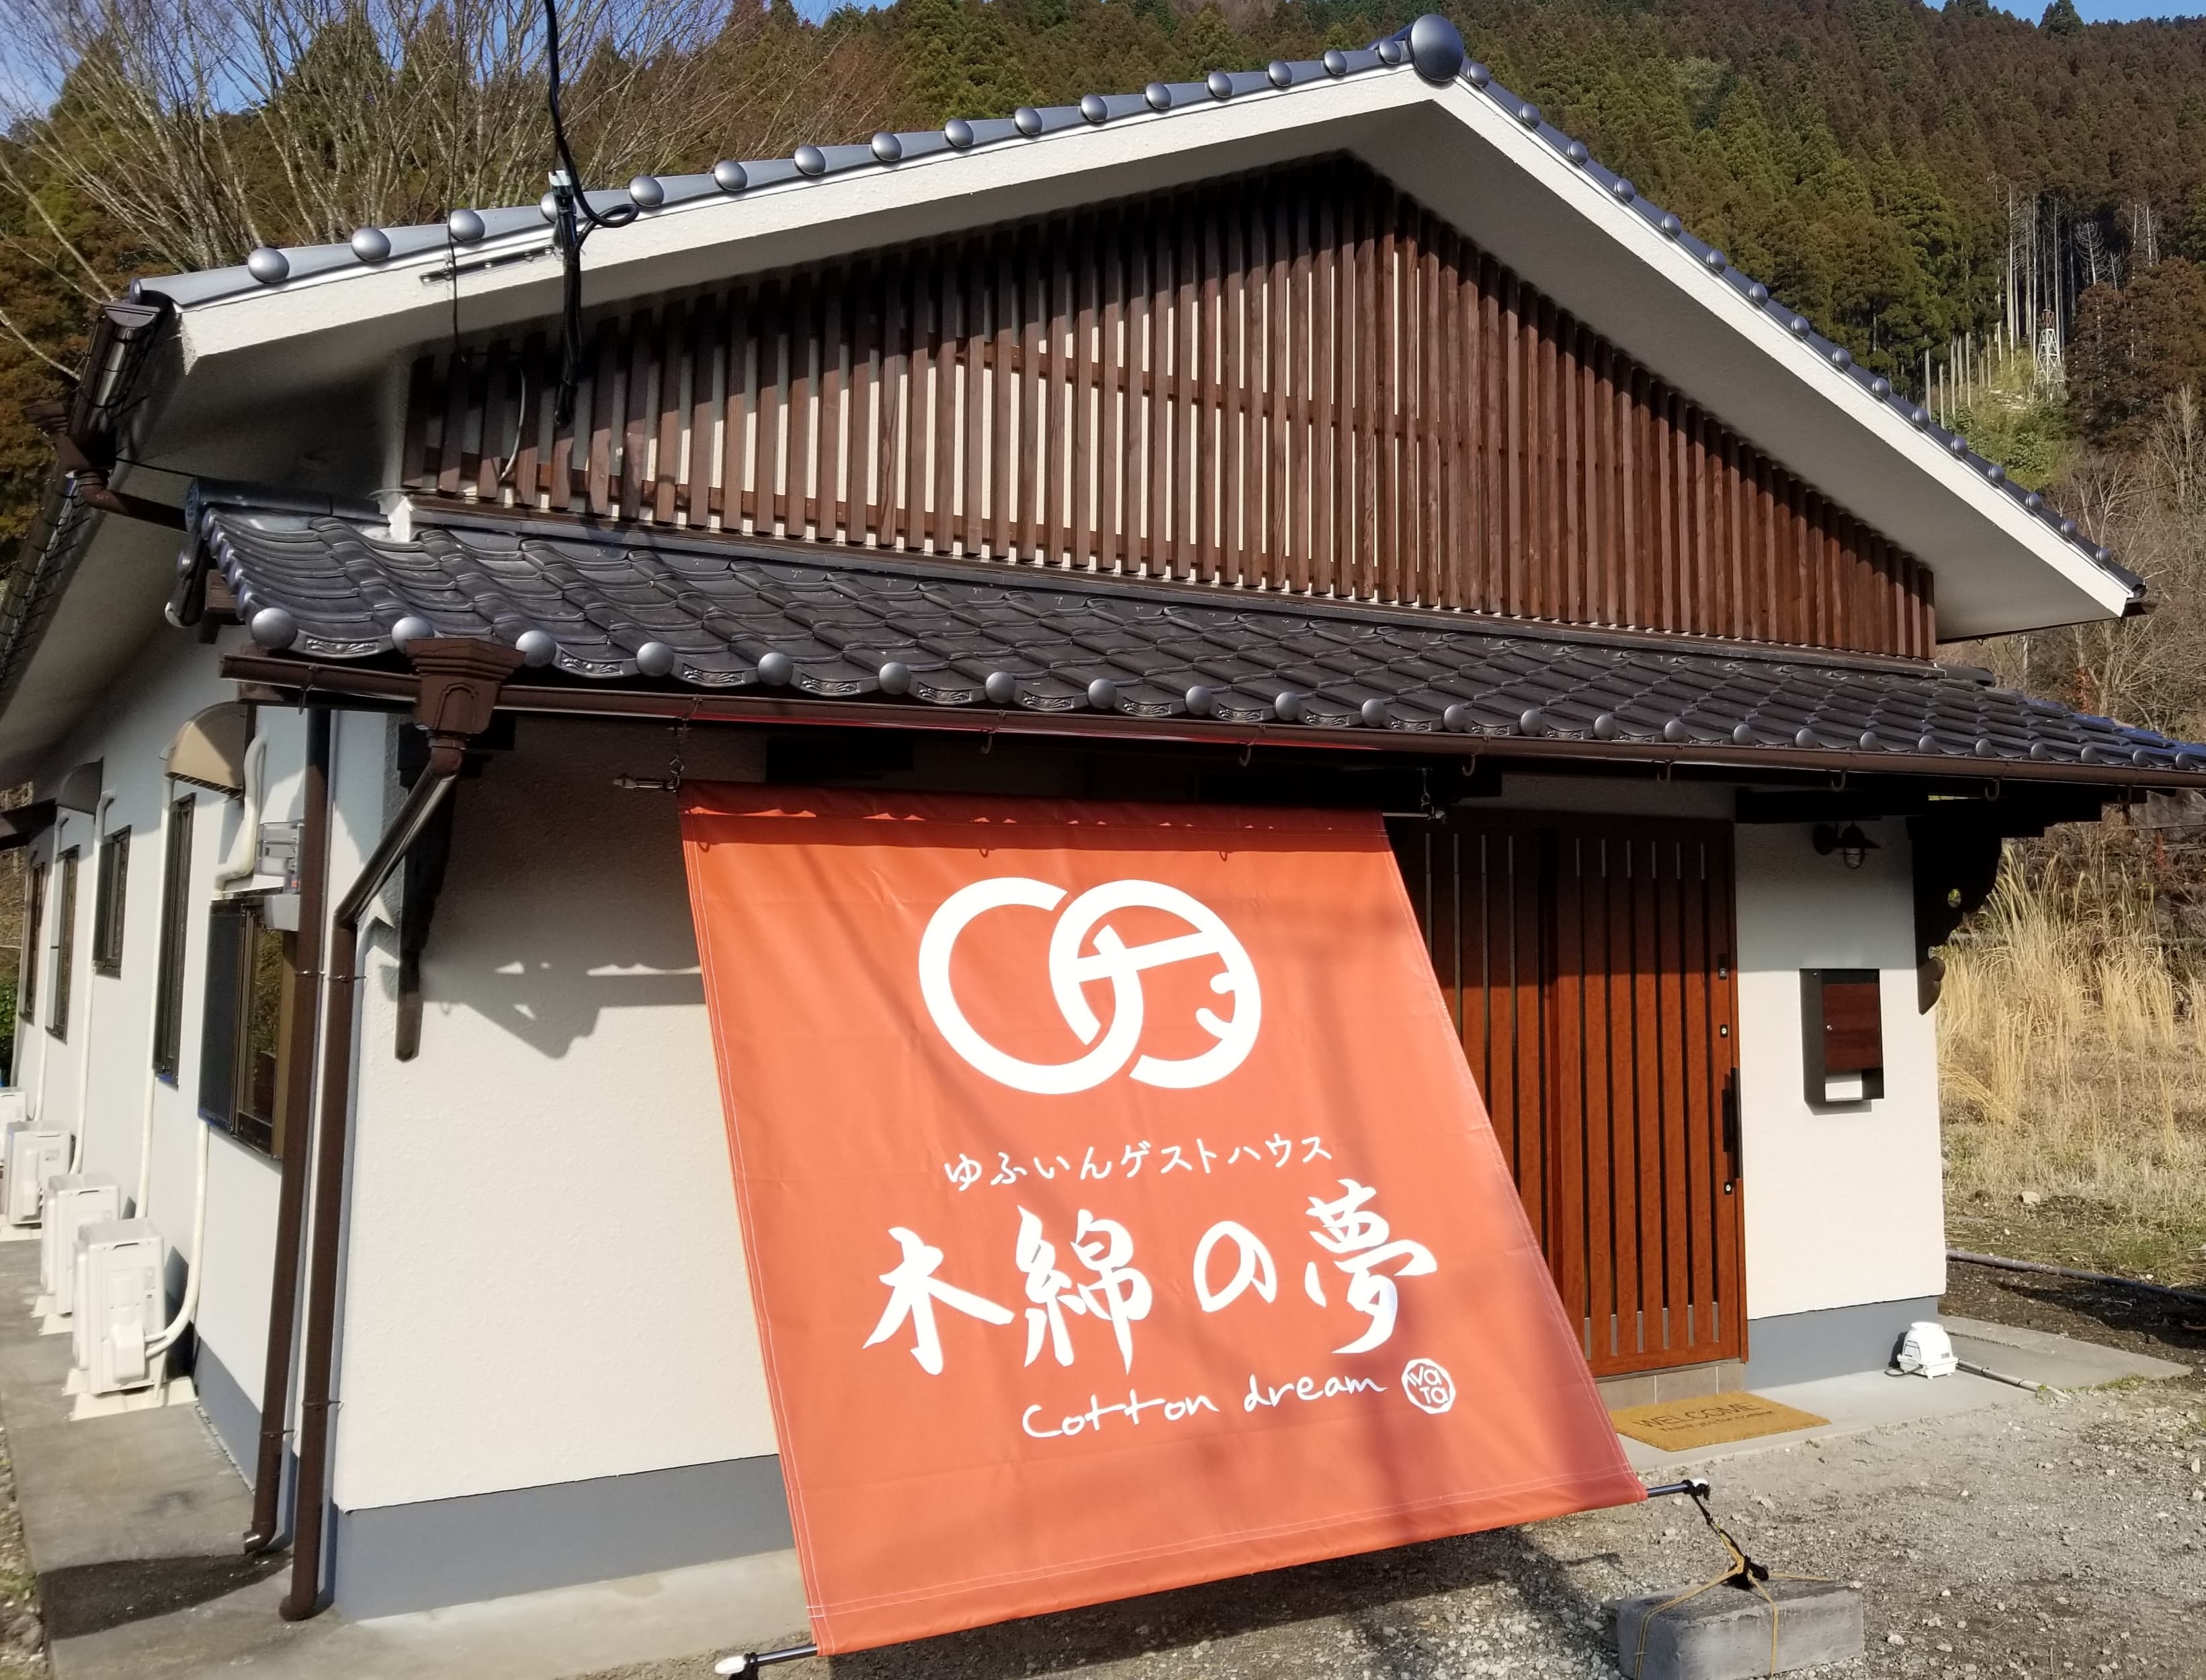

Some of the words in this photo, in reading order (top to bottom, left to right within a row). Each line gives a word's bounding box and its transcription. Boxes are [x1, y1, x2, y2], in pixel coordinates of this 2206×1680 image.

[943, 1133, 1333, 1191] ゆふいんゲストハウス
[862, 1178, 1438, 1376] 木綿の夢
[1244, 1374, 1388, 1413] dream
[1631, 1402, 1762, 1428] WELCOME
